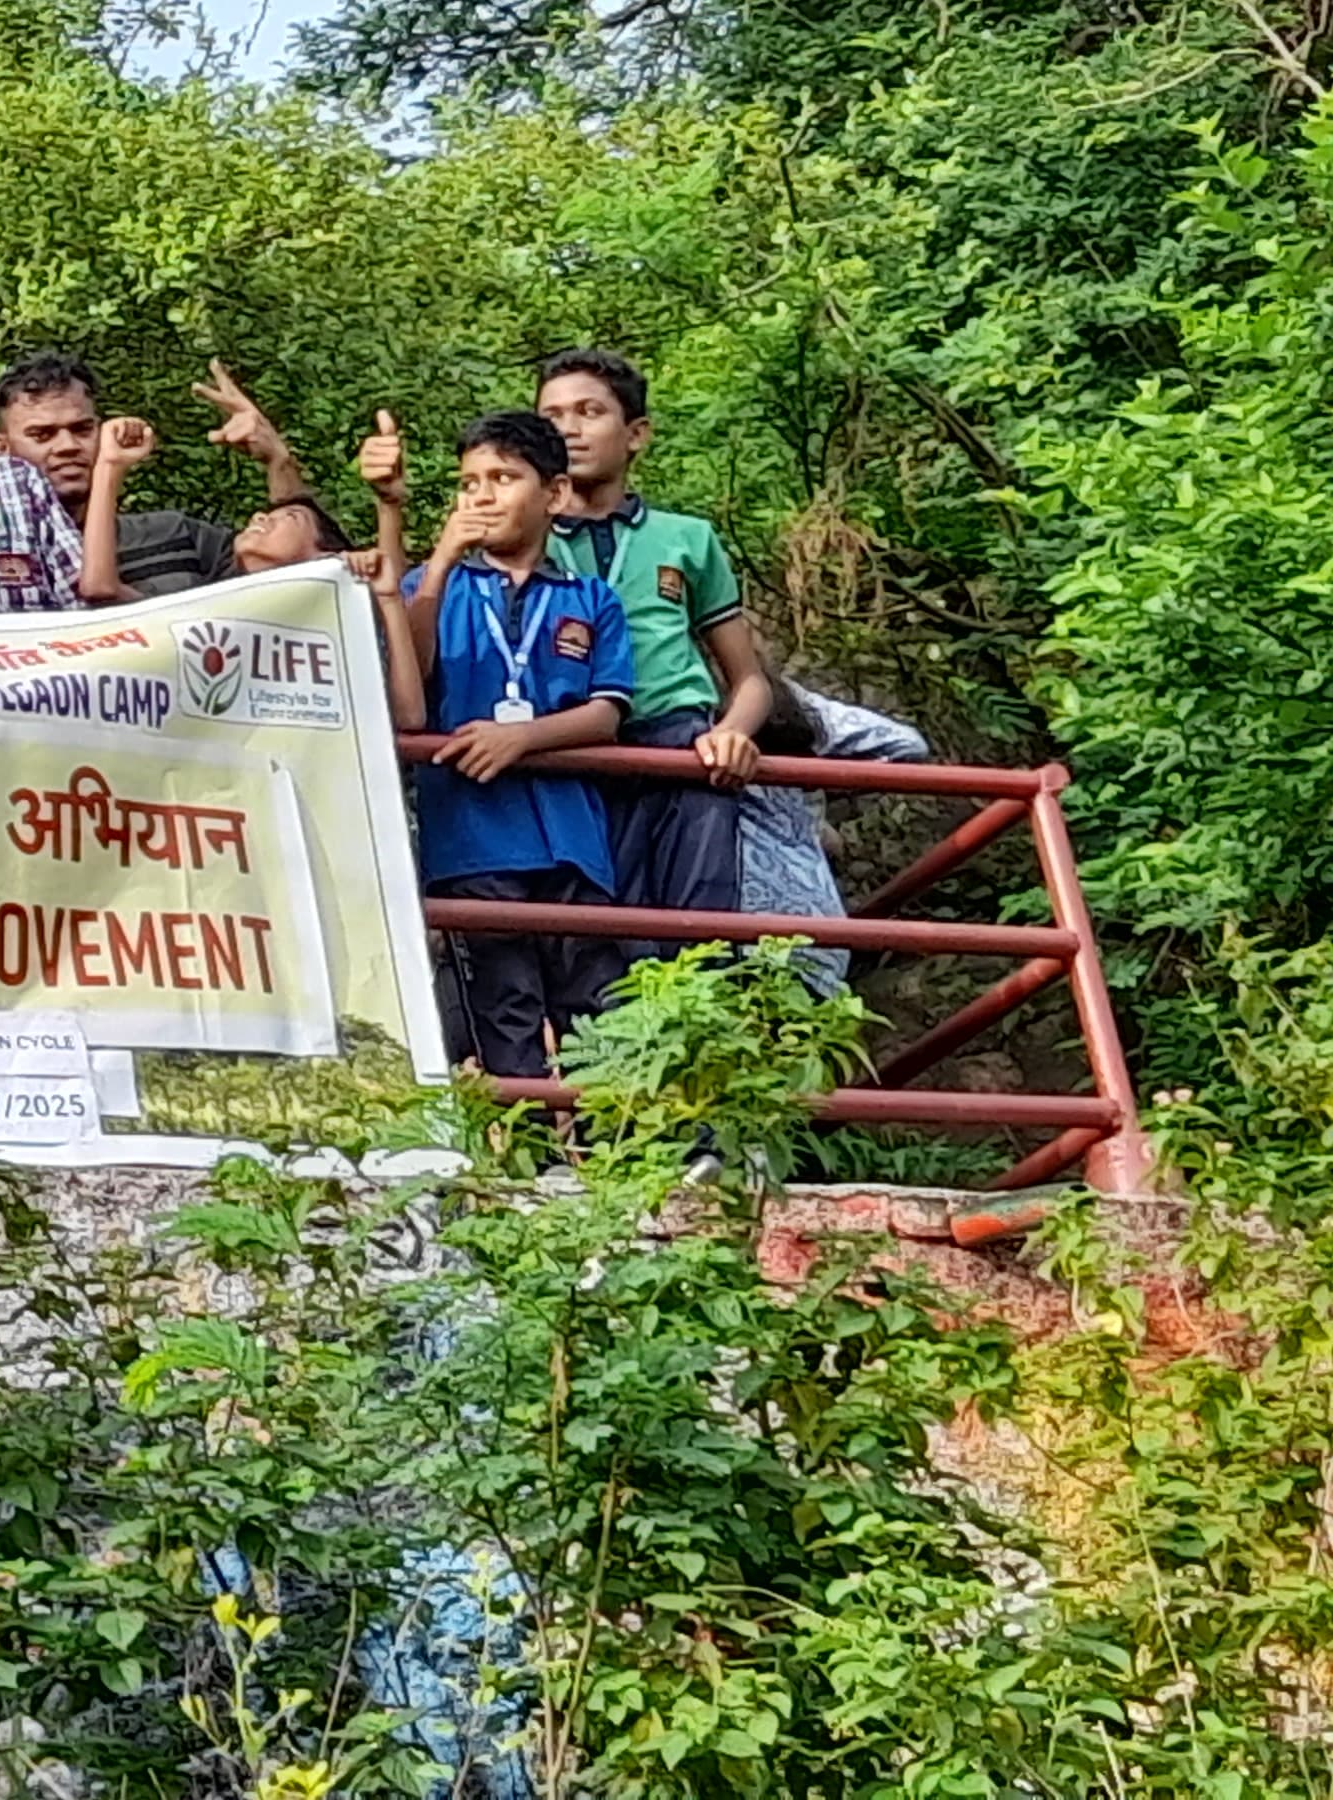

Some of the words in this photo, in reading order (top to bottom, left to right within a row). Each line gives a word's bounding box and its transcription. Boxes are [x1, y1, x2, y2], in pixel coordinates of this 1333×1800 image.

[251, 634, 334, 685] LiFE
[99, 675, 170, 728] CAMP
[7, 766, 249, 873] अभियान
[17, 1035, 75, 1050] CYCLE
